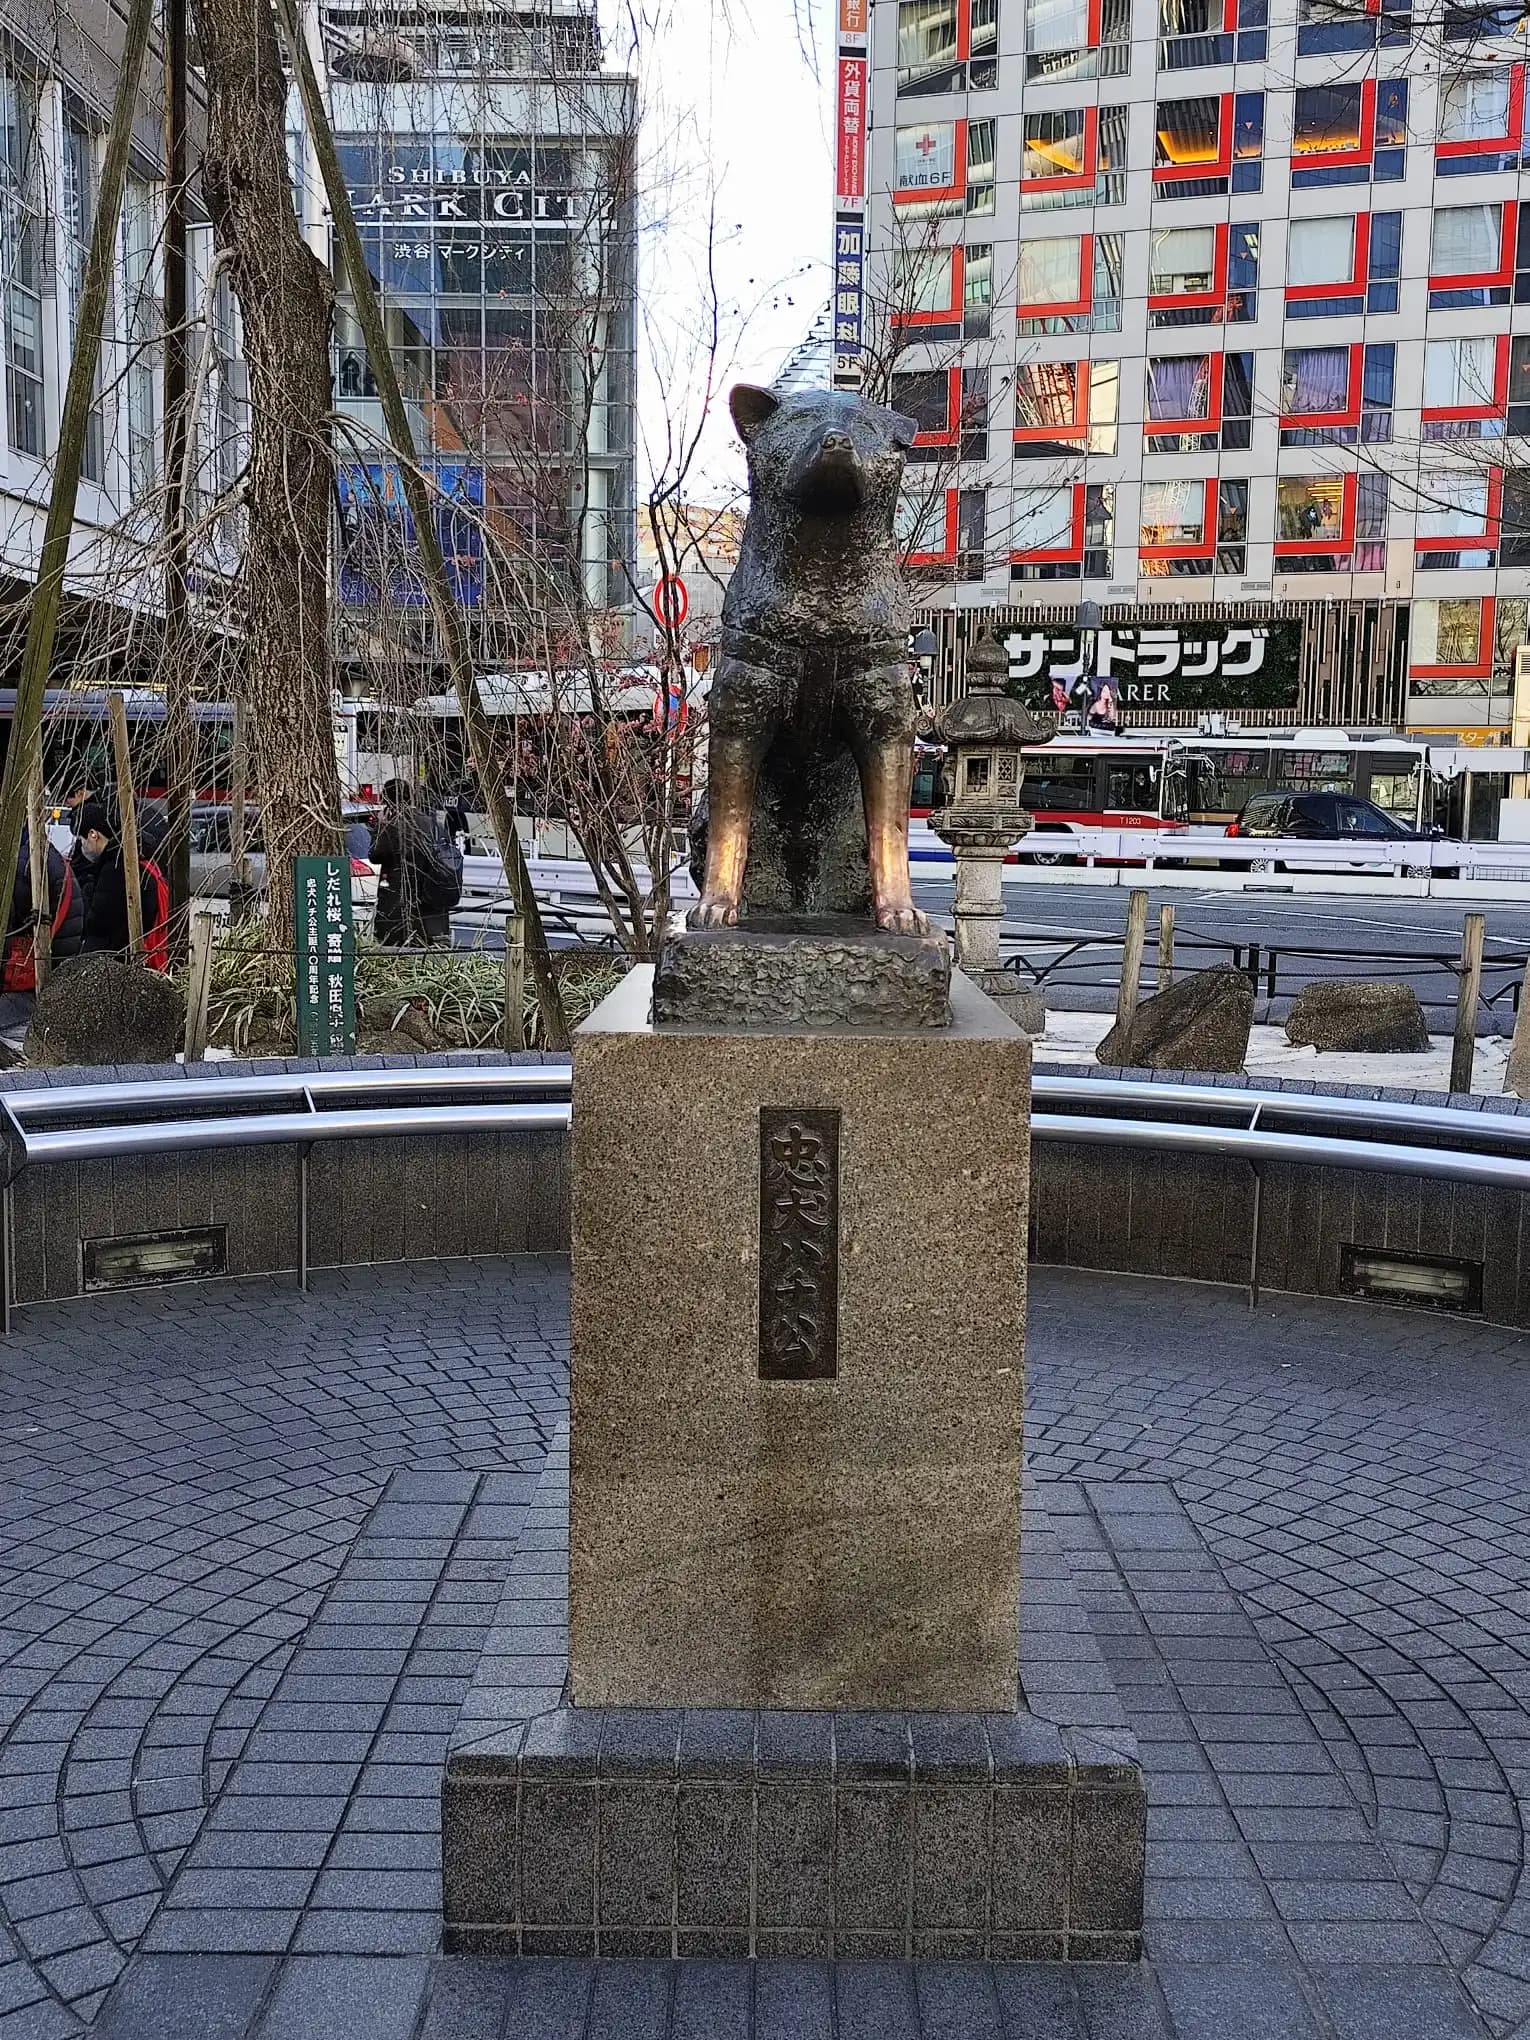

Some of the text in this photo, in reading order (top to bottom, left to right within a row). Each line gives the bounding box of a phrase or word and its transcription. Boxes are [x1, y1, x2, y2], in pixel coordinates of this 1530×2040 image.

[845, 33, 861, 43] 8F
[843, 62, 861, 134] 外貨両替
[388, 166, 533, 184] SHIBUYA
[900, 171, 952, 186] 献血6F
[841, 197, 858, 208] 7F
[837, 230, 860, 346] 加藤眼科
[1004, 629, 1270, 677] サンドラッグ
[1120, 817, 1141, 825] T1203
[326, 862, 342, 922] しだれ桜
